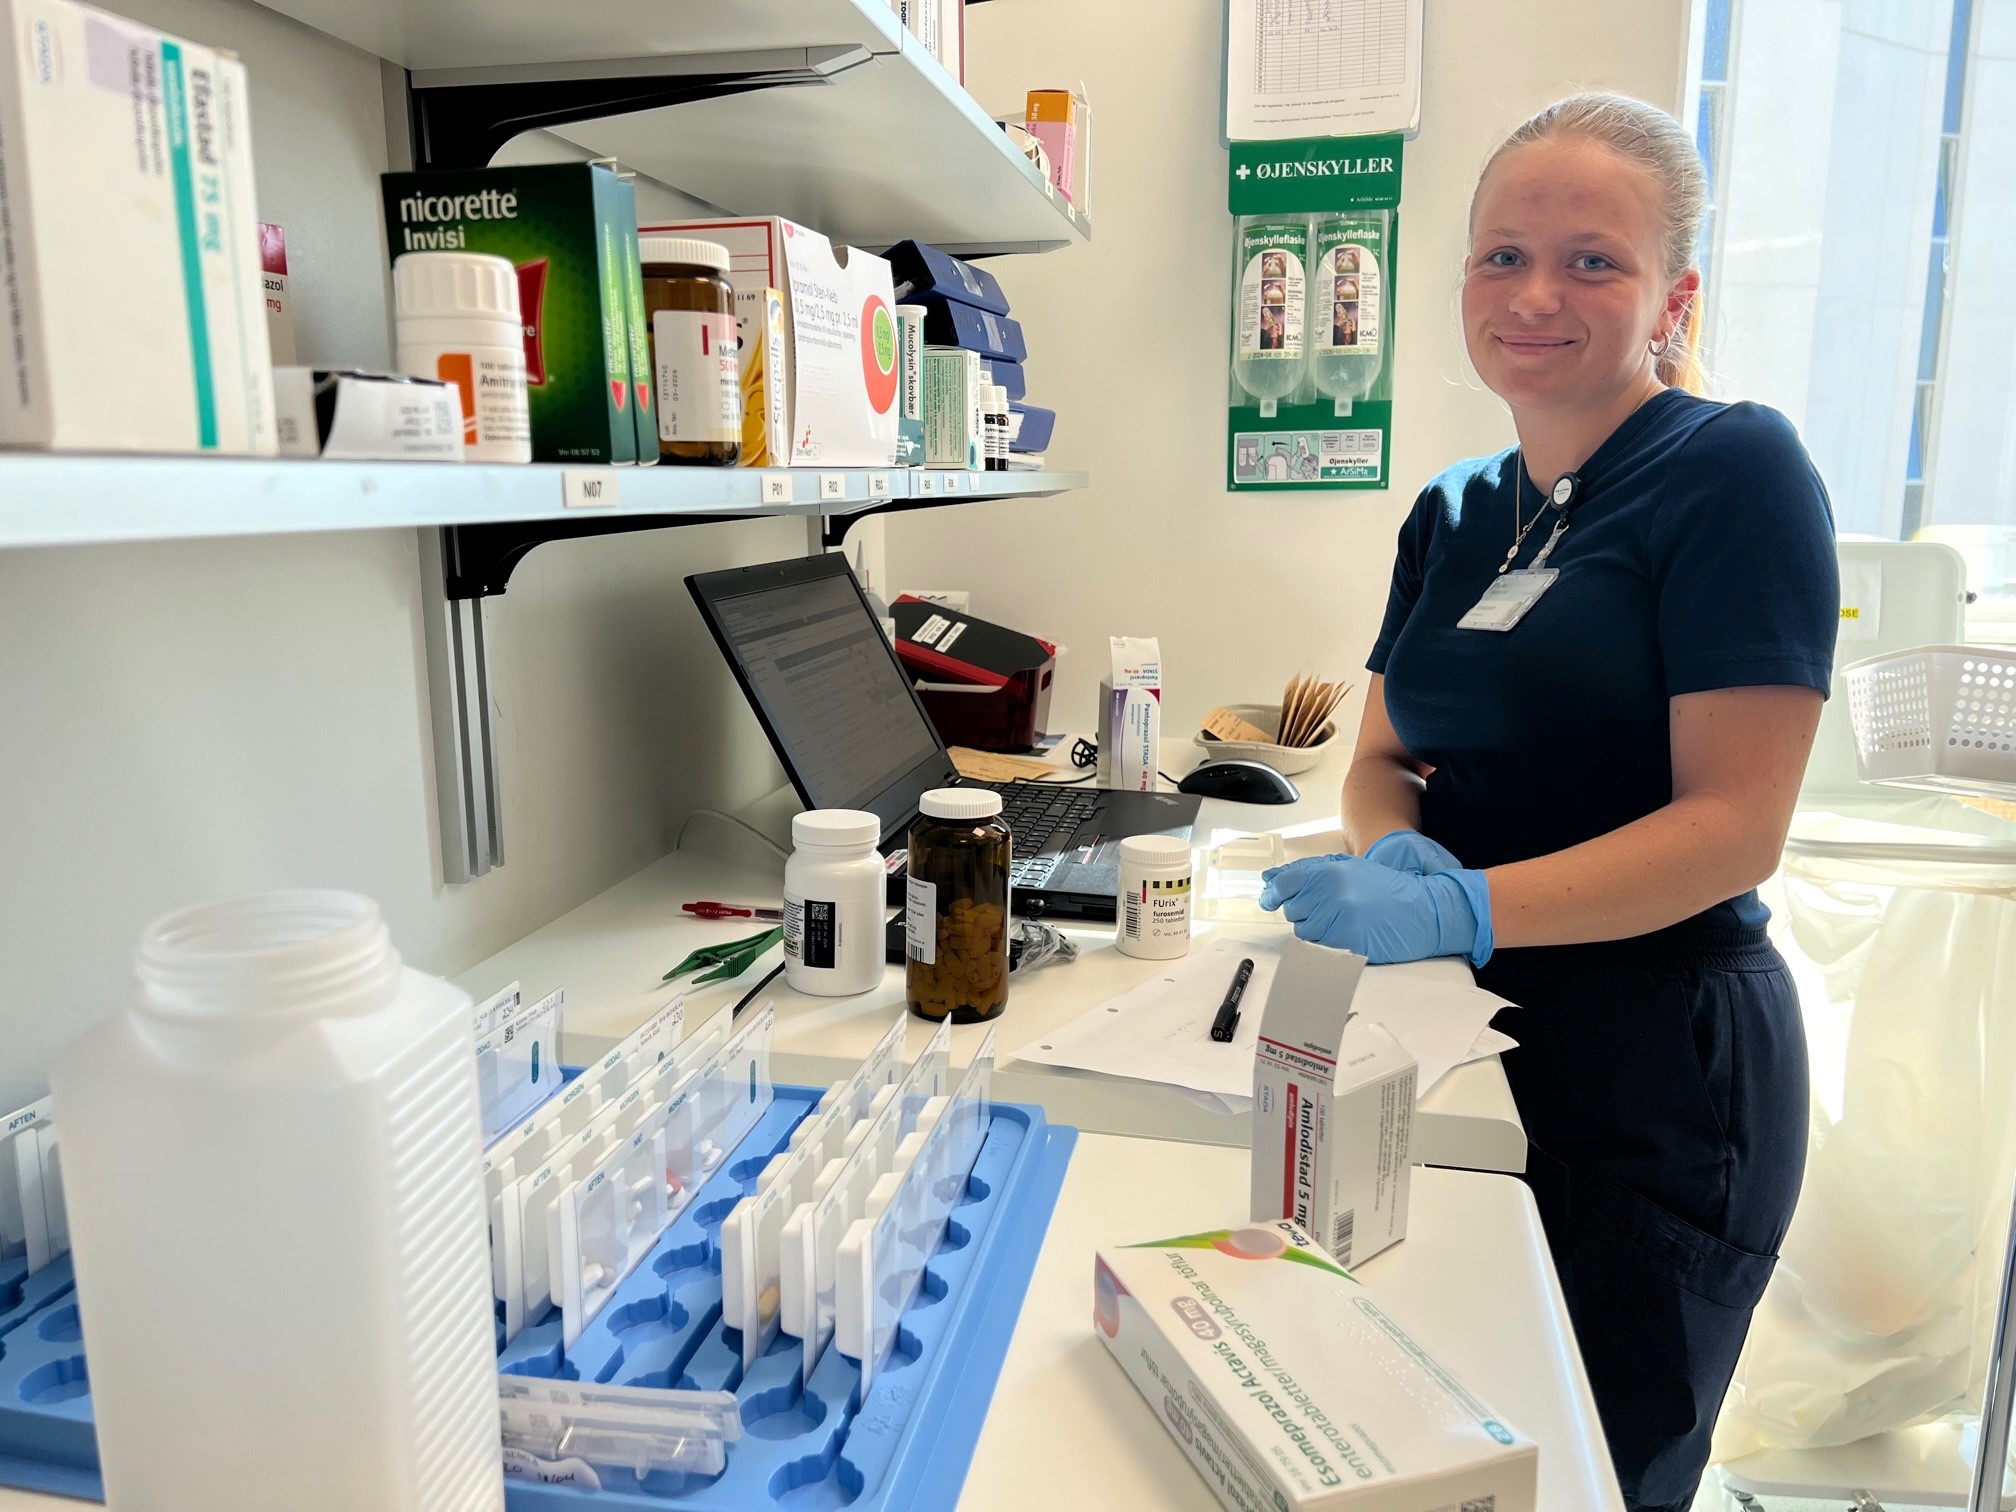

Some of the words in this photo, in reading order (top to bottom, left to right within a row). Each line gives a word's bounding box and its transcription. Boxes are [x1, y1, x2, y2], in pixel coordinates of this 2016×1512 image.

[1256, 158, 1394, 179] ØJENSKYLLER
[400, 189, 518, 223] nicorette
[404, 225, 465, 250] Invisi
[1244, 234, 1306, 248] Øjenskylleflaske
[1318, 229, 1380, 243] Øjenskylleflaske
[263, 278, 284, 292] azol
[266, 298, 282, 313] mg
[521, 324, 538, 337] re
[771, 337, 781, 425] Strepsils
[1340, 467, 1368, 476] ArSiMa
[583, 481, 603, 498] N07
[772, 482, 783, 497] P01
[829, 480, 838, 493] R02
[1142, 770, 1148, 780] 40
[1153, 908, 1185, 917] furosemid
[476, 1041, 491, 1056] DDAG
[1265, 1044, 1277, 1055] mg
[1303, 1042, 1332, 1055] amlodipin
[604, 1051, 622, 1070] MIDDAG
[1285, 1053, 1329, 1074] Amlodistad
[563, 1082, 585, 1104] MORGEN
[620, 1087, 640, 1111] MORGEN
[668, 1091, 688, 1114] MORGEN
[9, 1110, 36, 1131] AFTEN
[523, 1122, 535, 1137] NAT
[582, 1129, 593, 1143] NAT
[633, 1132, 643, 1148] NAT
[1298, 1097, 1314, 1188] Amlodistad
[482, 1159, 492, 1173] EN
[532, 1166, 552, 1189] AFTEN
[587, 1170, 605, 1194] AFTEN
[1298, 1189, 1310, 1201] 5
[1294, 1204, 1307, 1229] mg
[1278, 1223, 1310, 1247] teva
[1177, 1298, 1202, 1320] mg
[1192, 1314, 1215, 1340] 40
[1213, 1340, 1263, 1389] Actavis
[1249, 1386, 1343, 1488] Esomeprazol
[1195, 1437, 1225, 1486] Actavis
